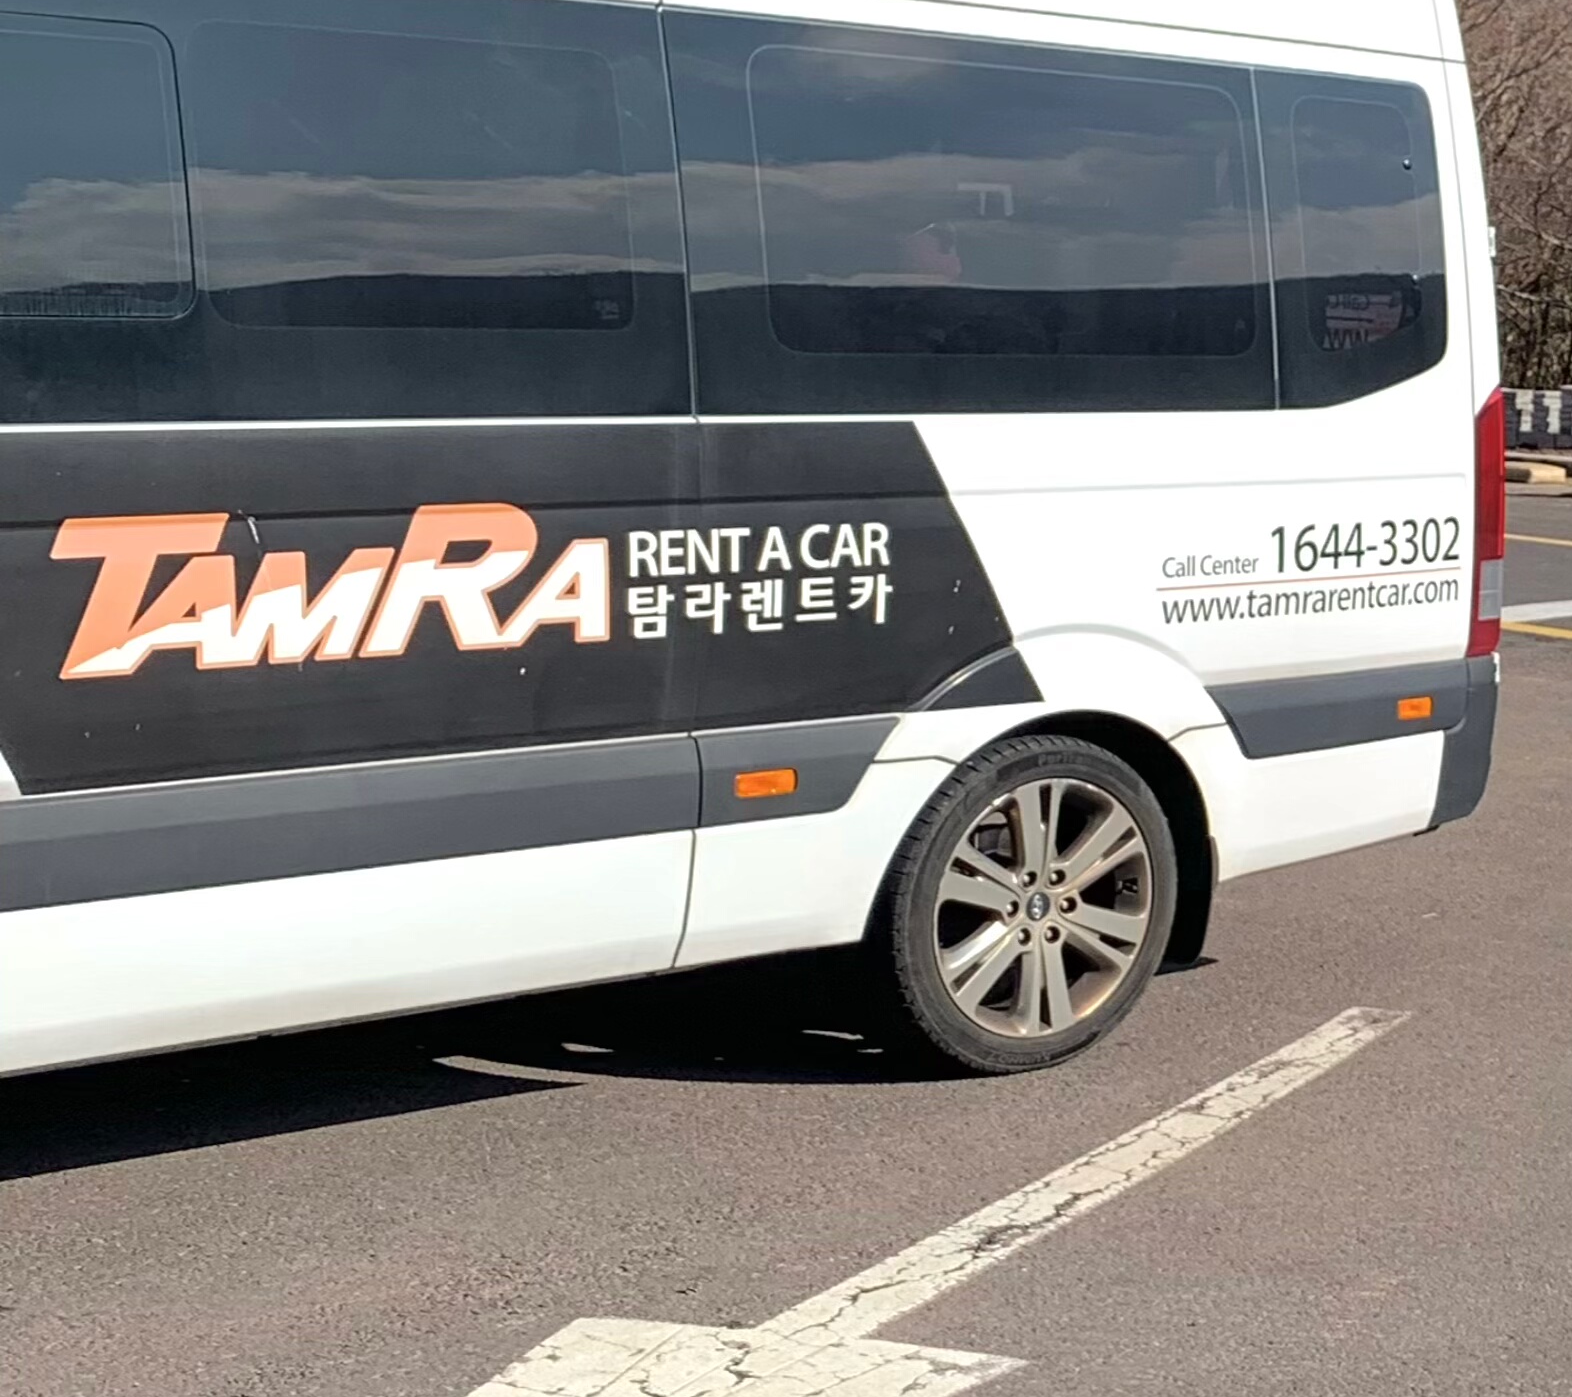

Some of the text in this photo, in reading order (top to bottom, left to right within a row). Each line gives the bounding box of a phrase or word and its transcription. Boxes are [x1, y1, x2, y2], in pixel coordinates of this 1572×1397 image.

[628, 522, 890, 577] RENT A CAR
[1162, 516, 1461, 578] Call Center 1644-3302
[50, 503, 609, 680] TAMRA
[627, 573, 893, 639] 탐라렌트카
[1162, 578, 1460, 624] www.tamrarentcar.com
